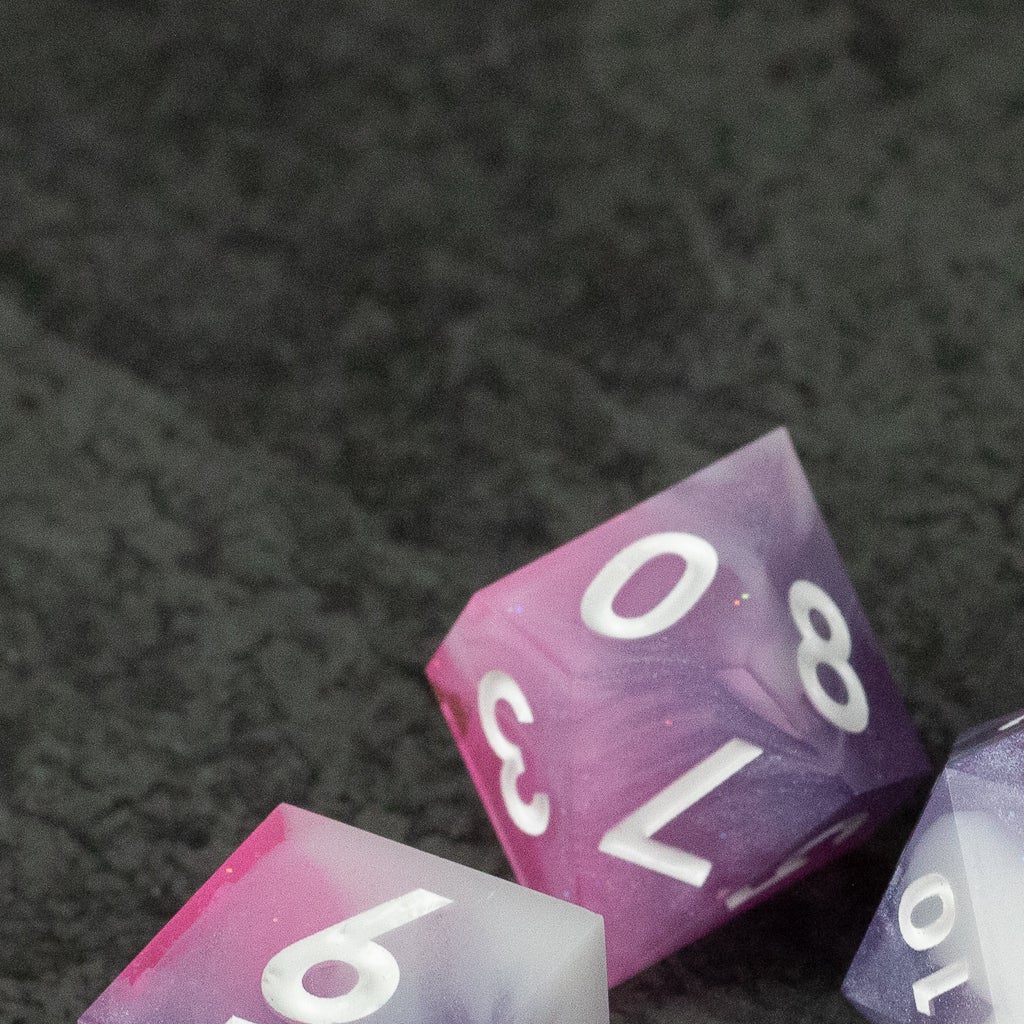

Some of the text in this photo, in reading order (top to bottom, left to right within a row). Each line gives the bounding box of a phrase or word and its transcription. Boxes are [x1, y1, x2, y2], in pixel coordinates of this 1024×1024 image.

[789, 579, 869, 734] 8
[477, 670, 551, 836] 3
[599, 737, 764, 888] 7
